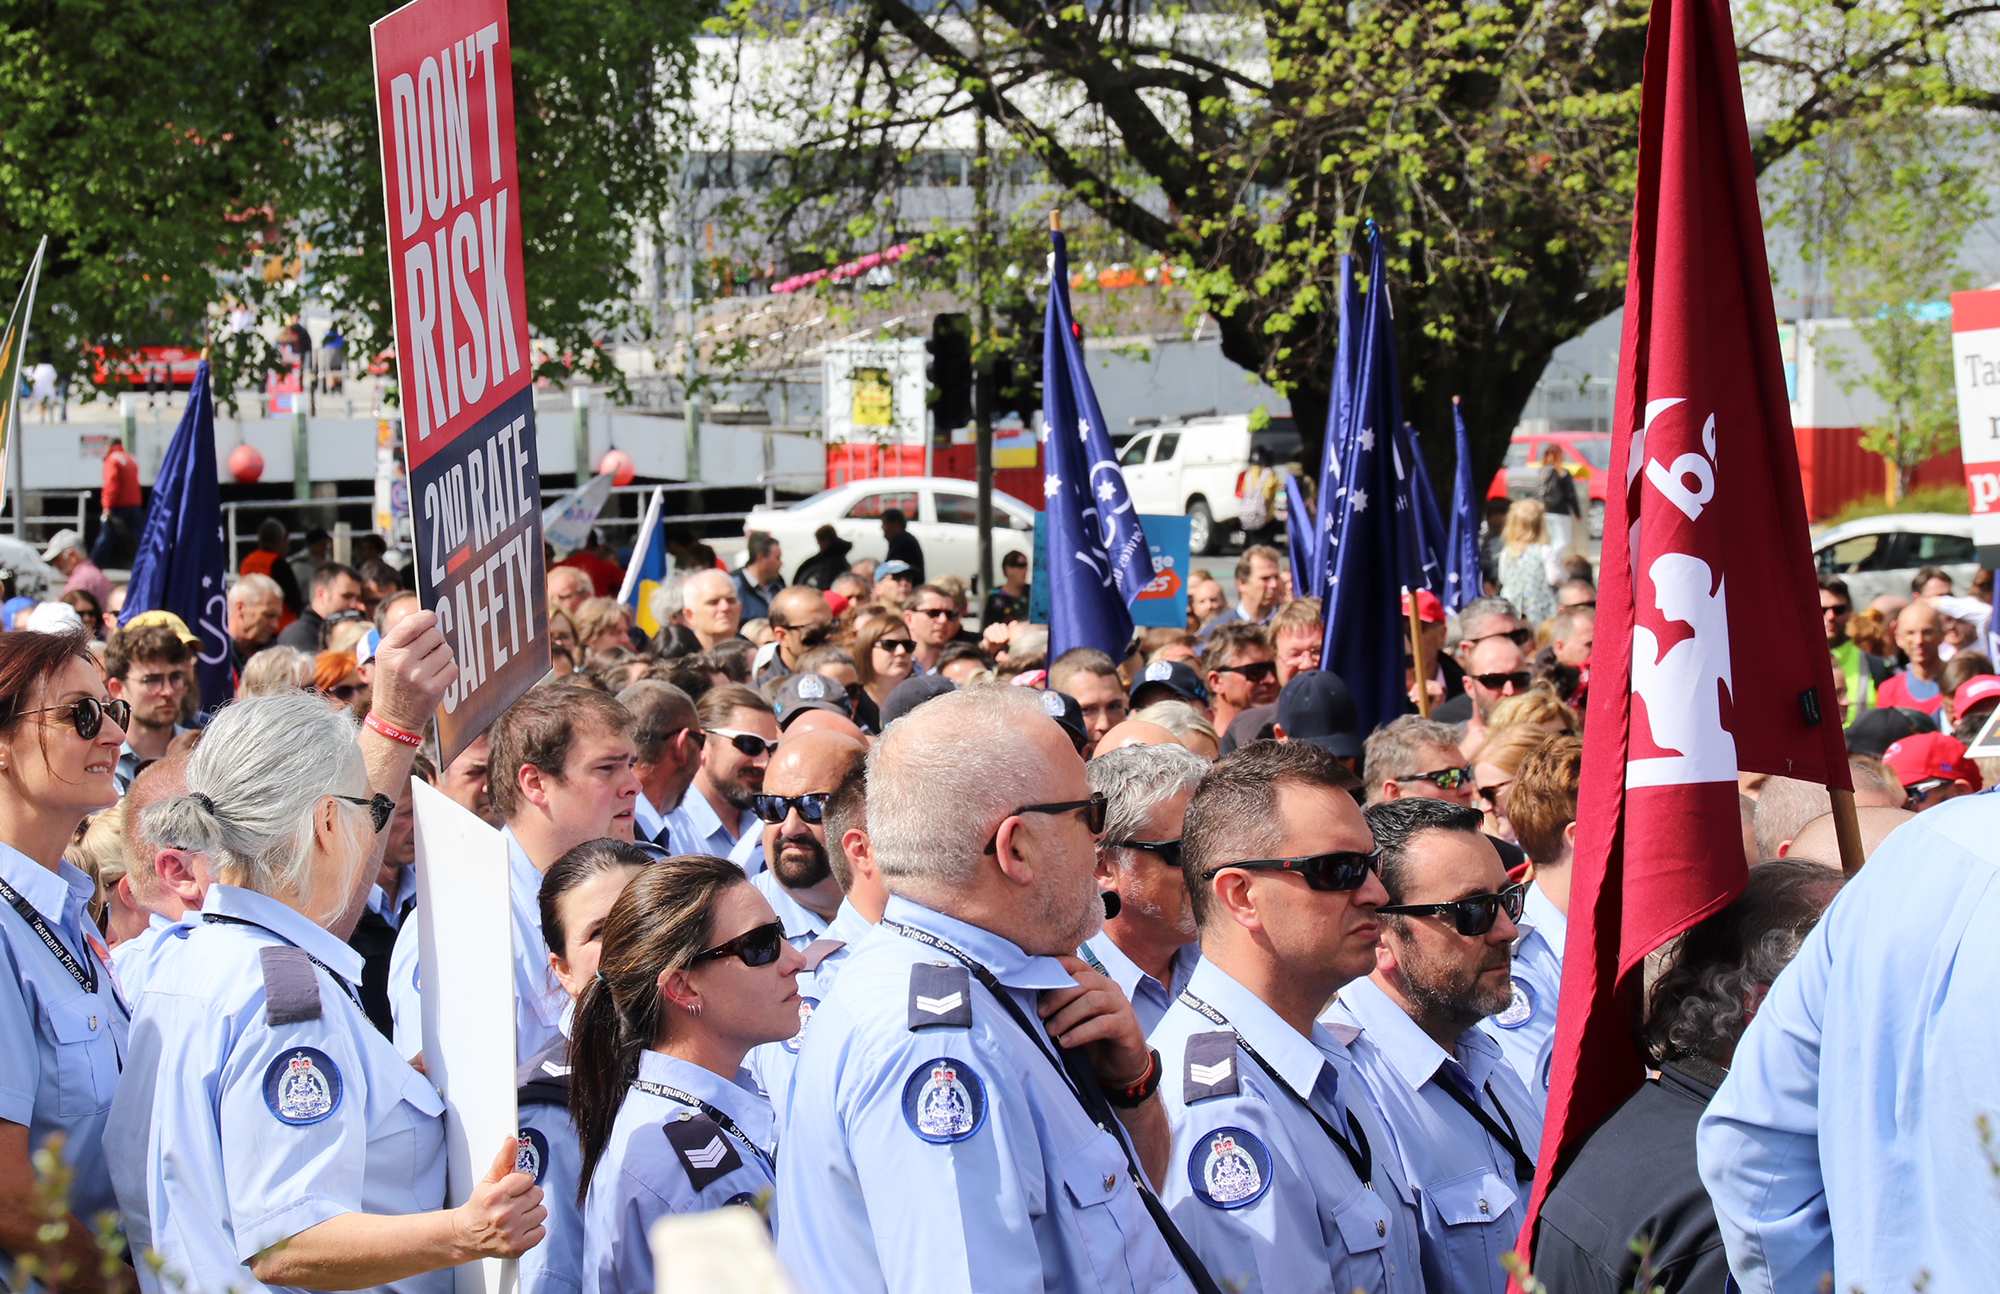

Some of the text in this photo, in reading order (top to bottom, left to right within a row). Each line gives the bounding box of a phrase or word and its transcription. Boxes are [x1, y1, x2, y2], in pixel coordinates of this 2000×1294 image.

[391, 21, 502, 240] DON'T
[404, 188, 521, 442] RISK
[424, 414, 532, 588] 2ND RATE
[32, 917, 85, 985] Tasmania Prison
[902, 925, 934, 945] Prison
[1198, 1003, 1225, 1024] Prison
